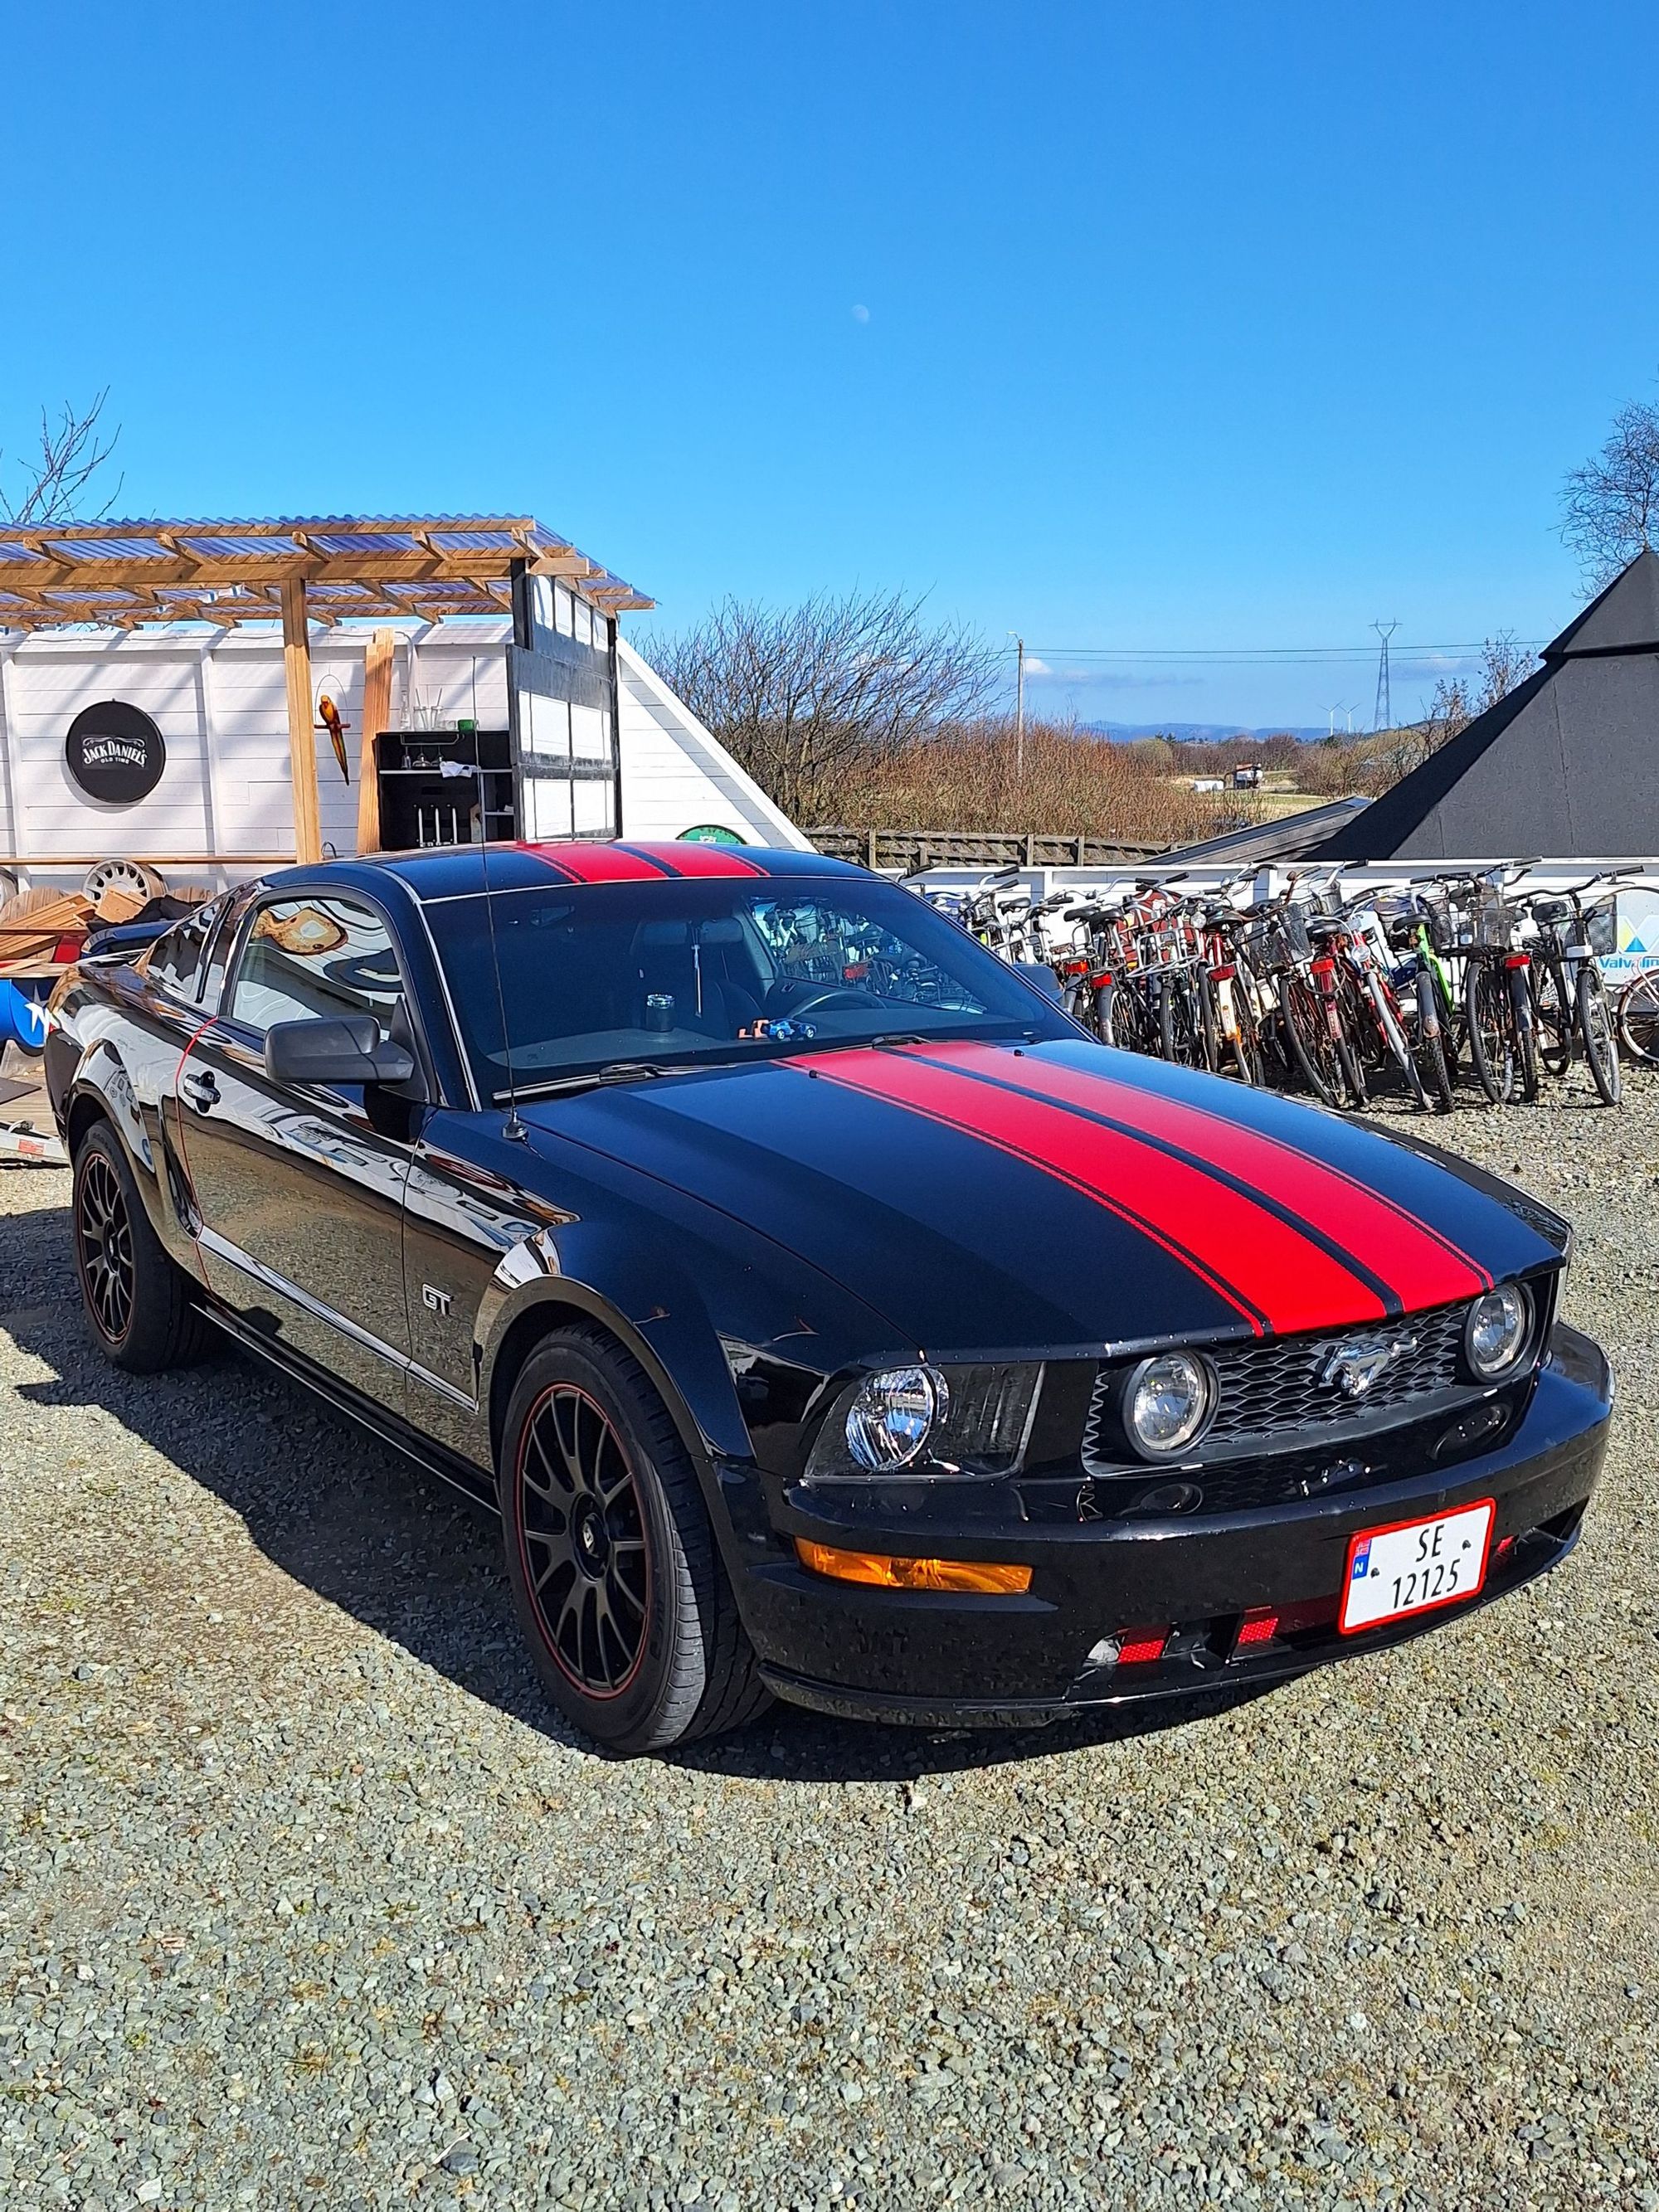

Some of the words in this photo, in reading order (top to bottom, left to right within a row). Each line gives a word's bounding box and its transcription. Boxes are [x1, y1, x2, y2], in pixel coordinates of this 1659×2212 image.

[83, 745, 108, 765] JACK
[422, 1283, 452, 1315] GT
[1415, 1524, 1445, 1563] SE
[1354, 1562, 1365, 1574] N
[1392, 1558, 1461, 1609] 12125
